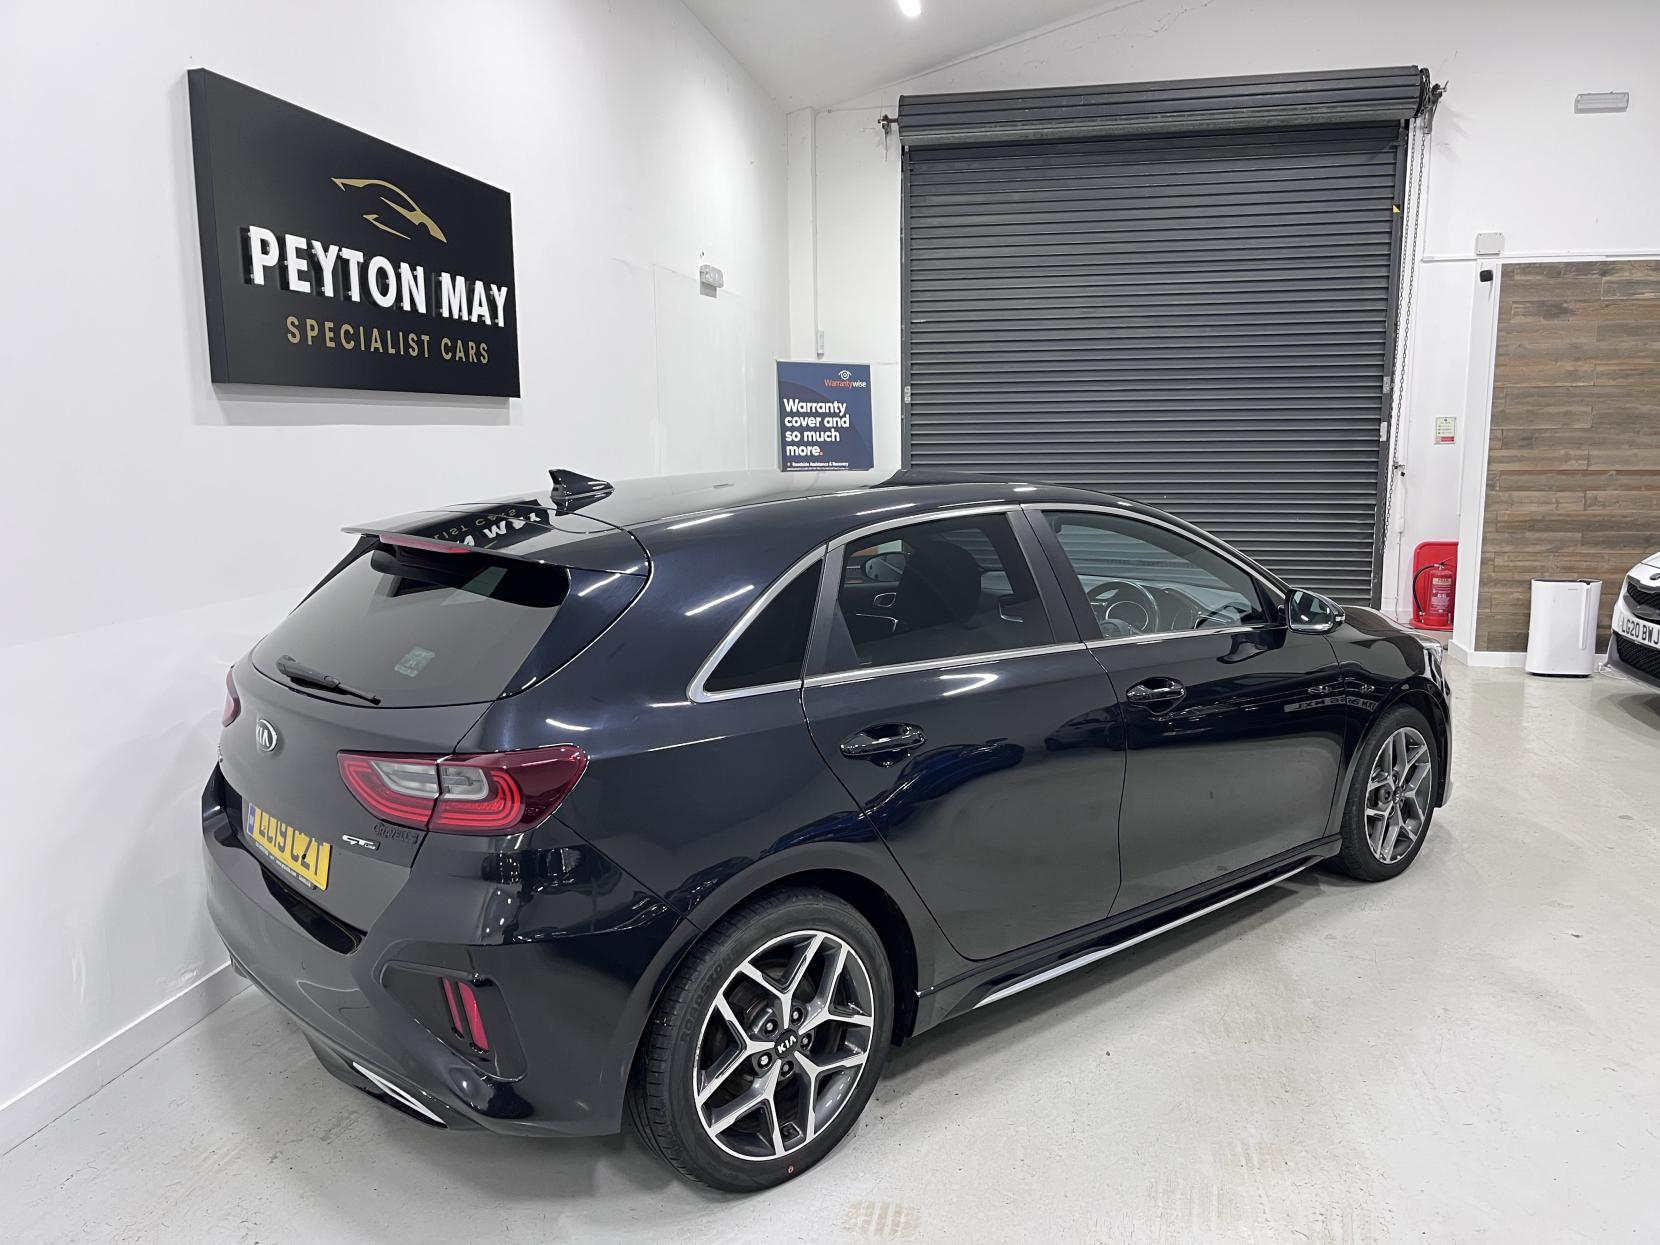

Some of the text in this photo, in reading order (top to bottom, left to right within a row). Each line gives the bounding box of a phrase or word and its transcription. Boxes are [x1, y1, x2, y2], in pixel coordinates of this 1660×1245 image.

[249, 225, 508, 327] PEYTON MAY
[286, 315, 489, 364] SPECIALIST CARS
[824, 379, 867, 389] Warrantywise
[783, 398, 847, 416] Warranty
[784, 414, 850, 427] cover and
[785, 428, 840, 442] so much
[786, 445, 823, 456] more.
[1622, 617, 1640, 638] LG20
[777, 1035, 797, 1054] KIA
